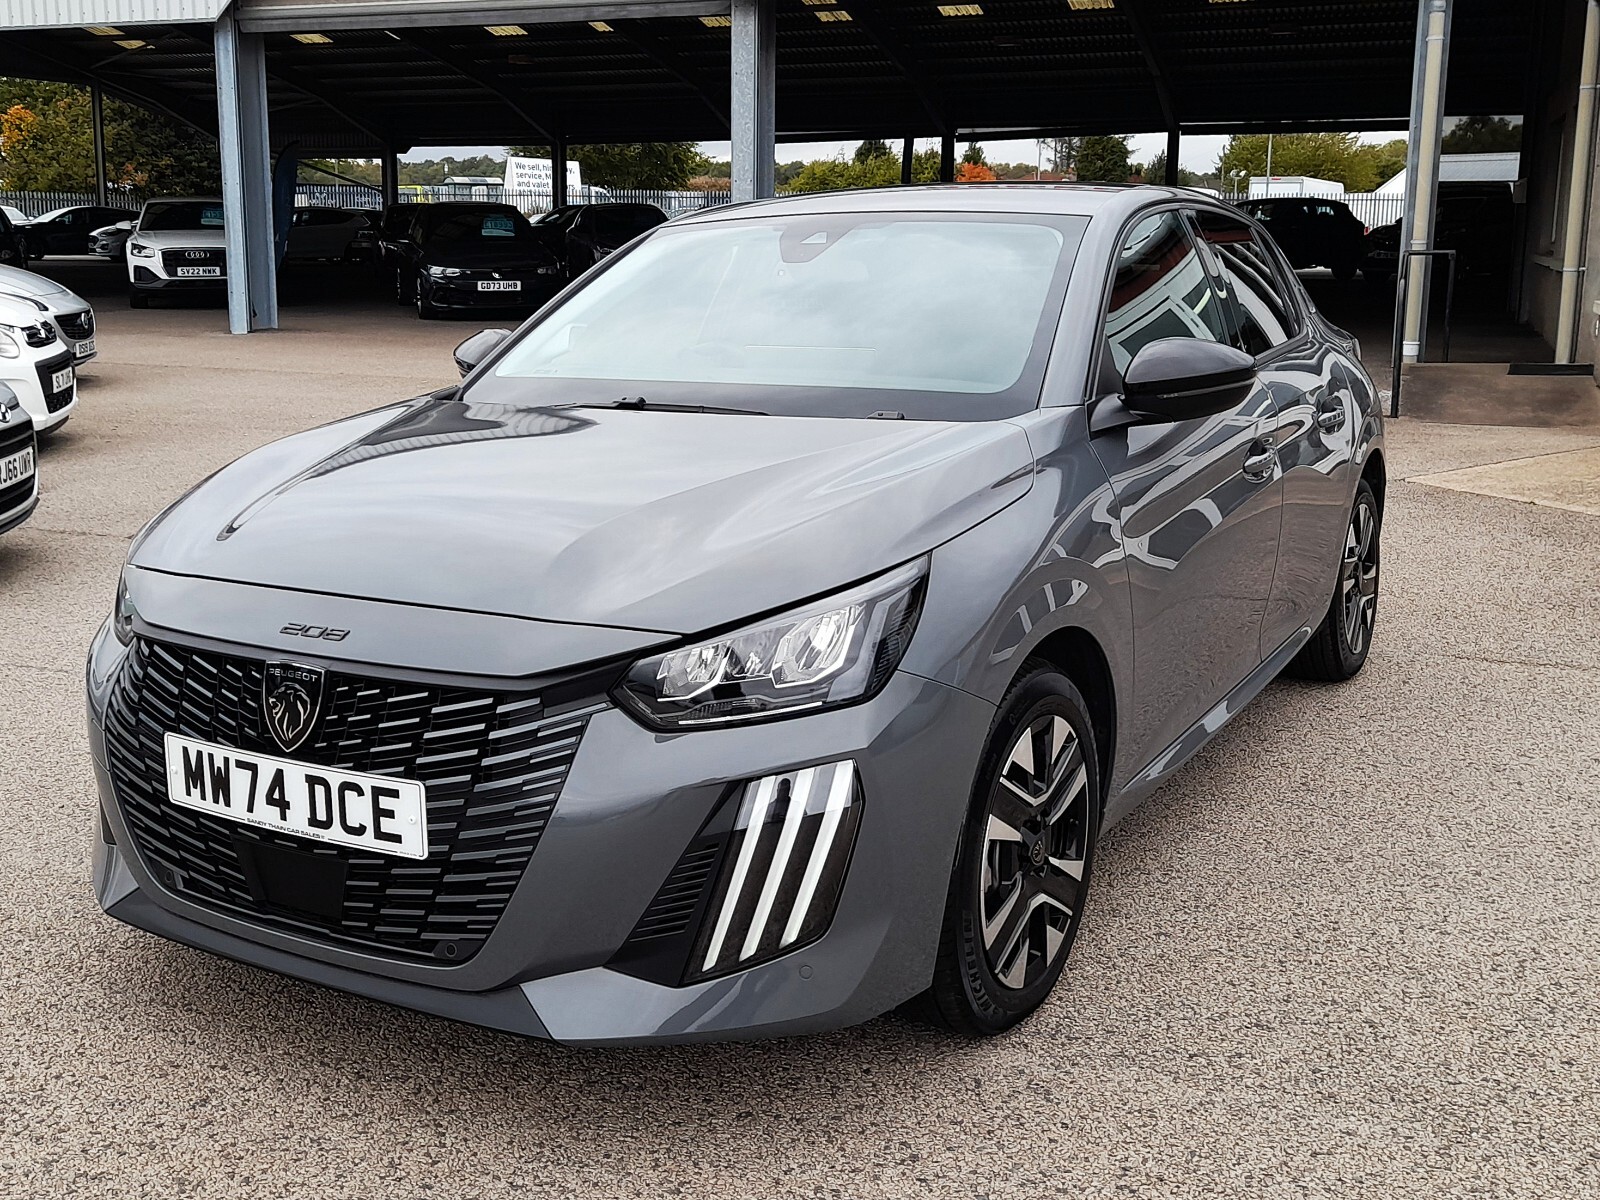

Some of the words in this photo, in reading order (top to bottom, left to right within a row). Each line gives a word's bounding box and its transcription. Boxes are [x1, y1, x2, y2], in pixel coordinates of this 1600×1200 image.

[515, 161, 526, 170] We
[527, 163, 542, 172] sell,
[516, 171, 545, 181] service,
[516, 180, 531, 188] and
[531, 181, 550, 189] valet
[180, 267, 201, 276] SV22
[202, 267, 218, 276] NWK
[480, 281, 501, 290] GD73
[502, 281, 518, 290] UHB
[279, 622, 351, 642] 208
[268, 668, 318, 682] PEUGEOT
[181, 745, 291, 822] MW74
[304, 773, 403, 845] DCE
[246, 817, 267, 826] SANDY
[267, 822, 286, 832] THAIN
[286, 826, 300, 835] CAR
[300, 830, 321, 840] SALES
